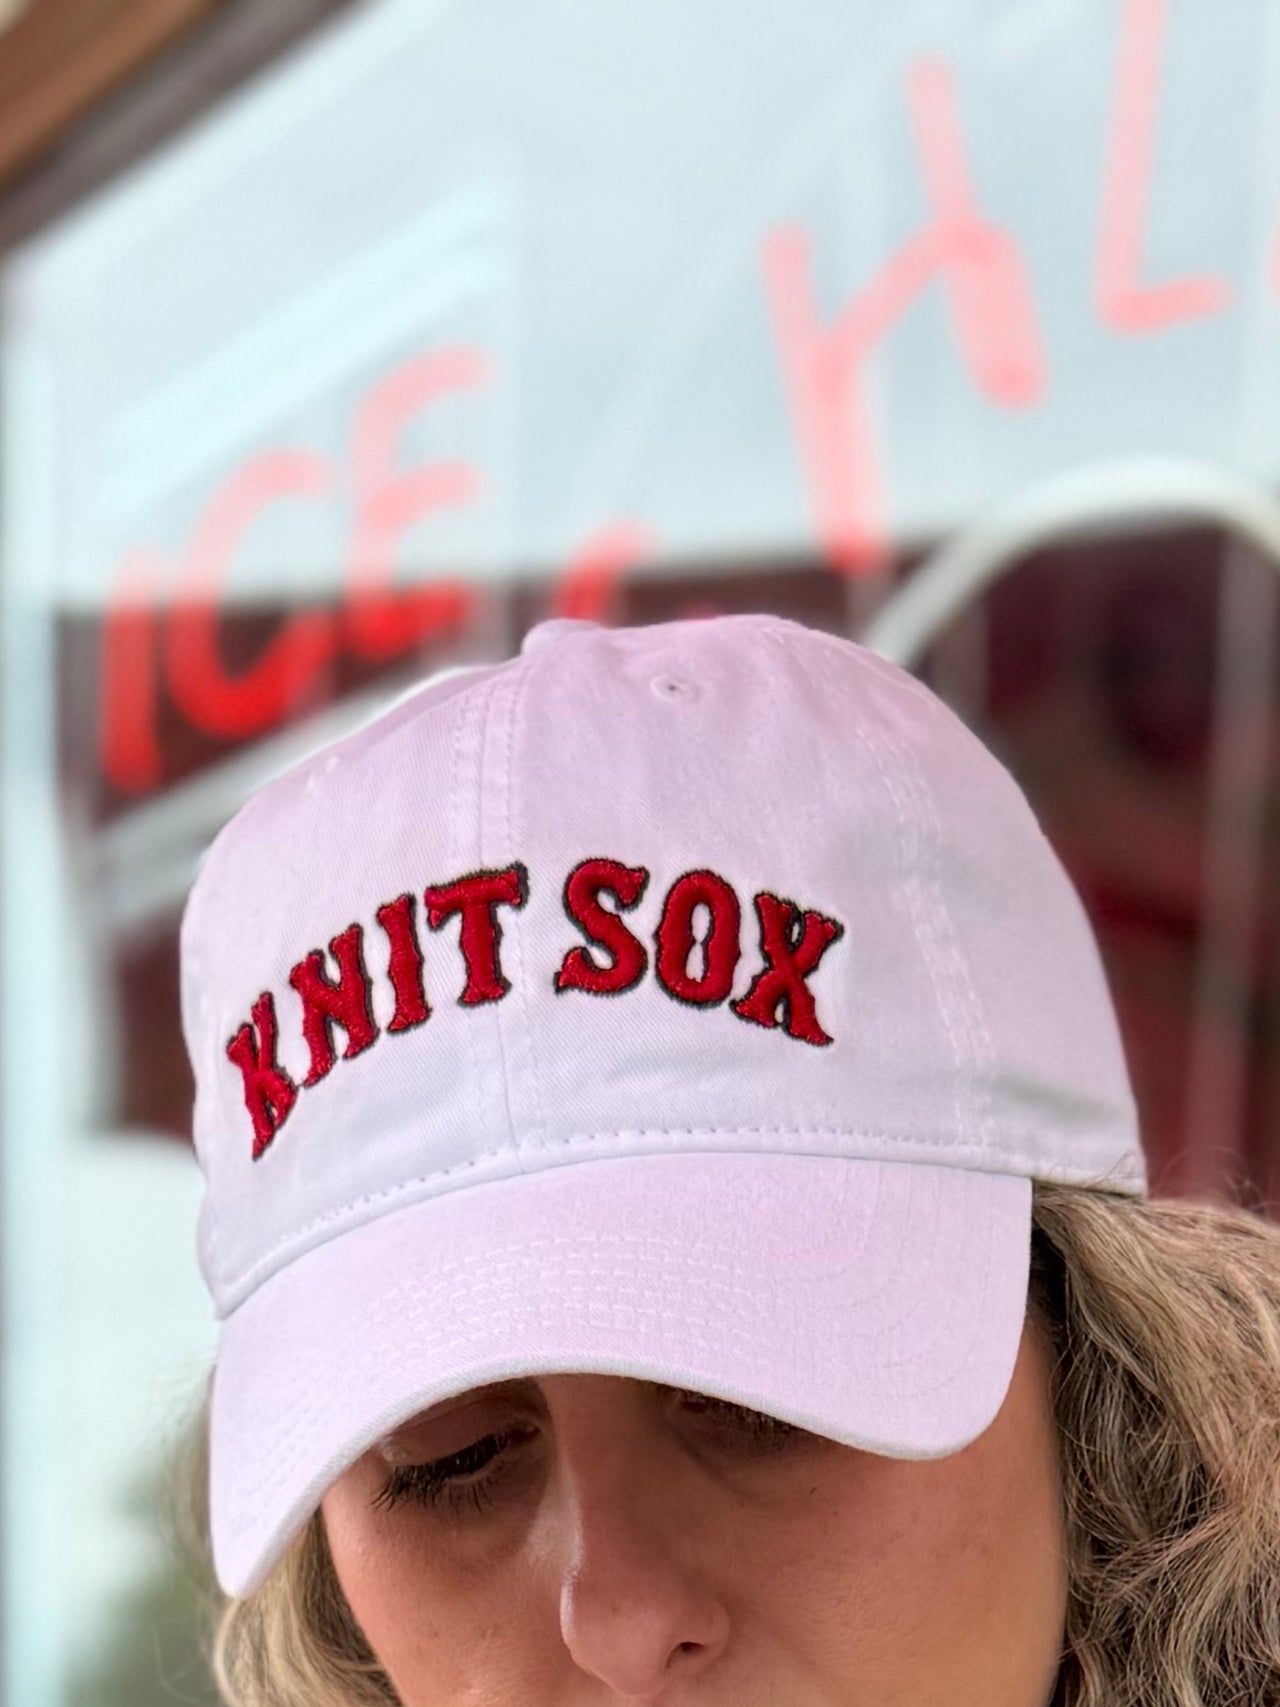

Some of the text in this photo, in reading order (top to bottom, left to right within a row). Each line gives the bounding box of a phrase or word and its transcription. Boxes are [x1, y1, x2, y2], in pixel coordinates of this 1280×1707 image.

[98, 342, 496, 795] ICE
[225, 856, 845, 1159] KNIT SOX
